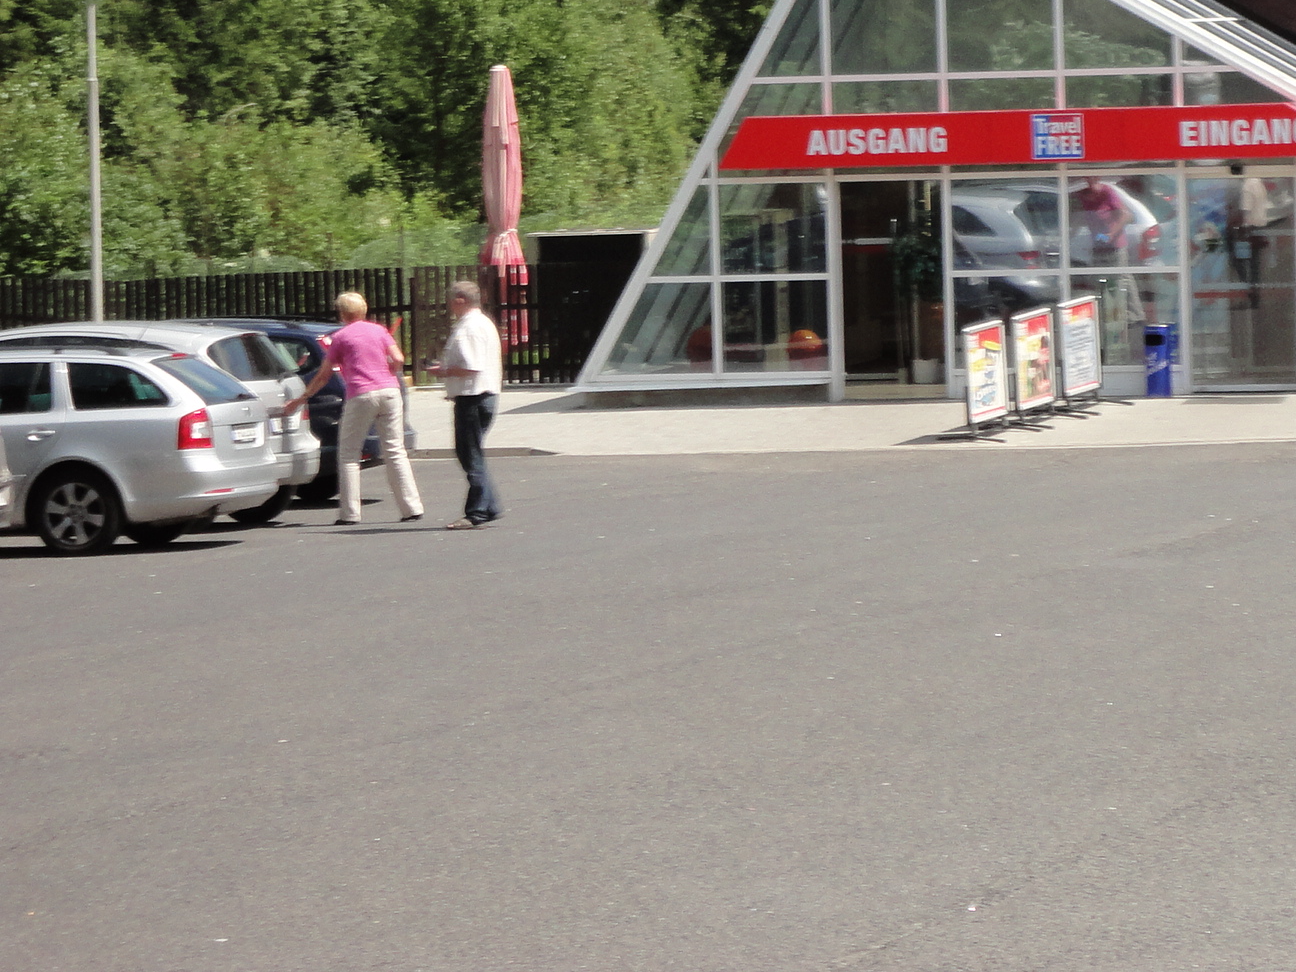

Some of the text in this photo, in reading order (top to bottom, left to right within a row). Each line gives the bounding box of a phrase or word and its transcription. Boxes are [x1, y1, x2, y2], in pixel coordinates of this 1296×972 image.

[1032, 117, 1082, 134] Travel
[806, 127, 949, 156] AUSGANG
[1035, 135, 1082, 155] FREE
